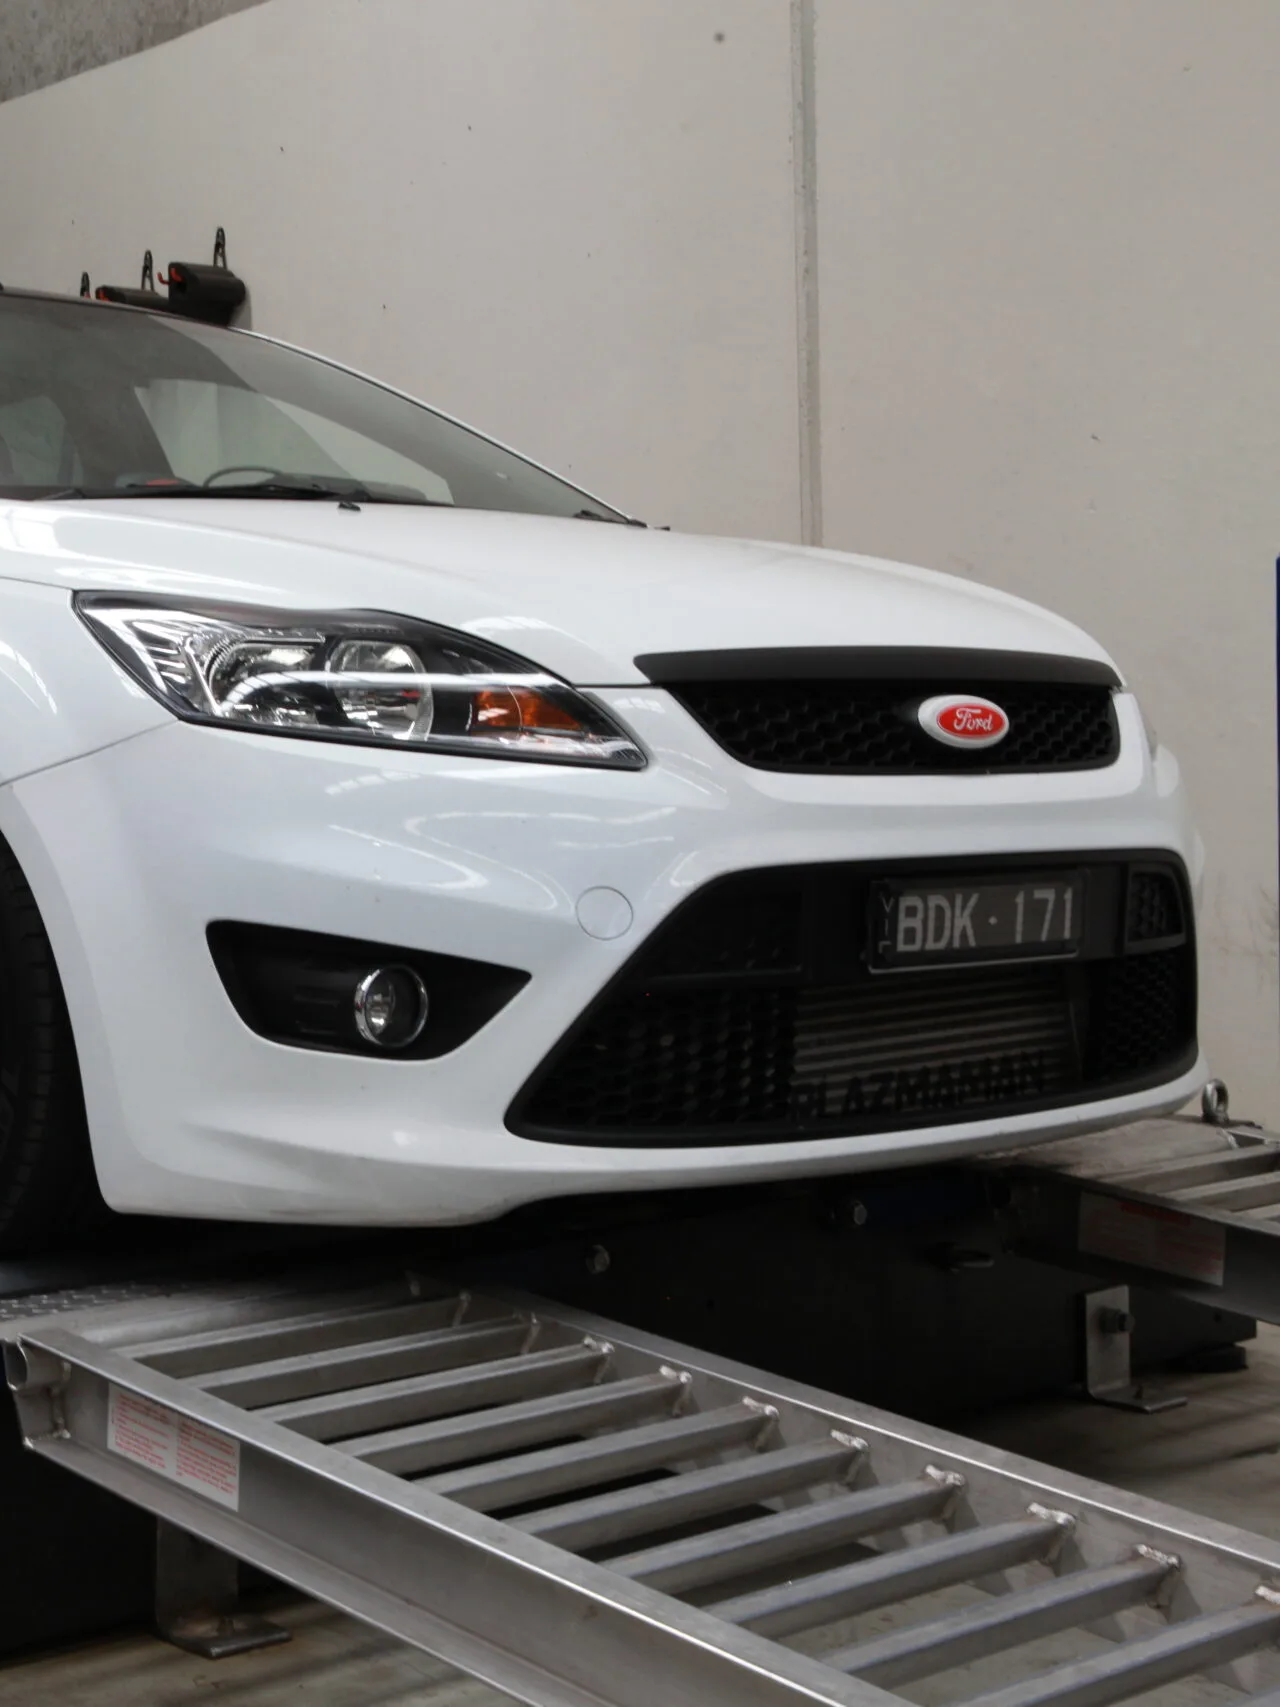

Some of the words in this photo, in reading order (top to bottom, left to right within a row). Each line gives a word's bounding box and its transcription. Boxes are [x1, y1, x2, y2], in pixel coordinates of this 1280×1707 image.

[953, 707, 993, 731] Ford
[896, 892, 979, 952] BDK
[1014, 886, 1073, 944] 171
